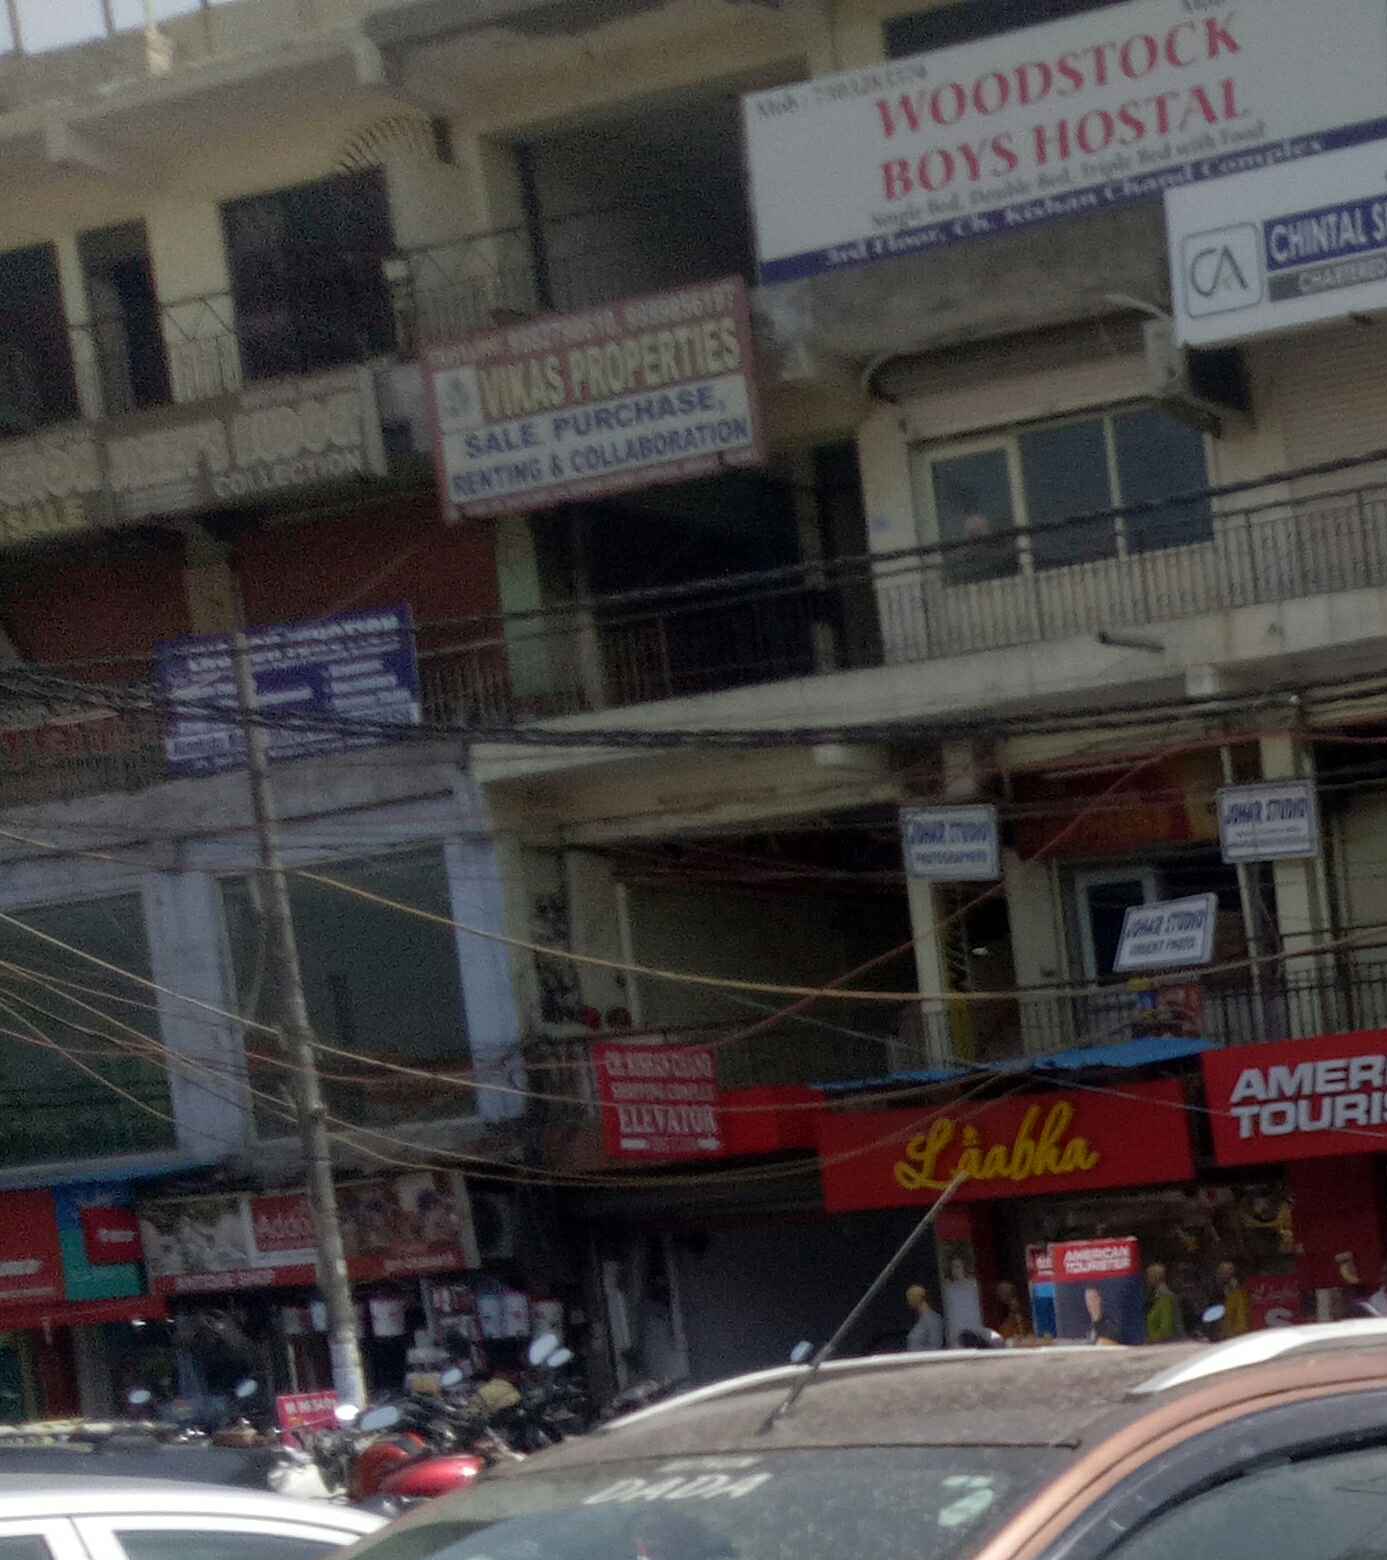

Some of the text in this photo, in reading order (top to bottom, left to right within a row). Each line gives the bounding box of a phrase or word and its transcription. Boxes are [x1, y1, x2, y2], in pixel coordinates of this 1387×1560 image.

[876, 10, 1241, 139] WOODSTOCK
[880, 78, 1247, 200] BOYS HOSTAL
[1269, 205, 1367, 263] CHINTAL
[480, 353, 566, 423] VIKAS
[568, 317, 742, 401] PROPERTIES
[453, 457, 543, 497] RENTING
[551, 453, 564, 479] &
[570, 416, 748, 475] COLLABORATION
[464, 384, 726, 459] SALE PURCHASE,
[211, 446, 363, 499] COLLECTION
[1063, 1245, 1131, 1263] AMERICAN
